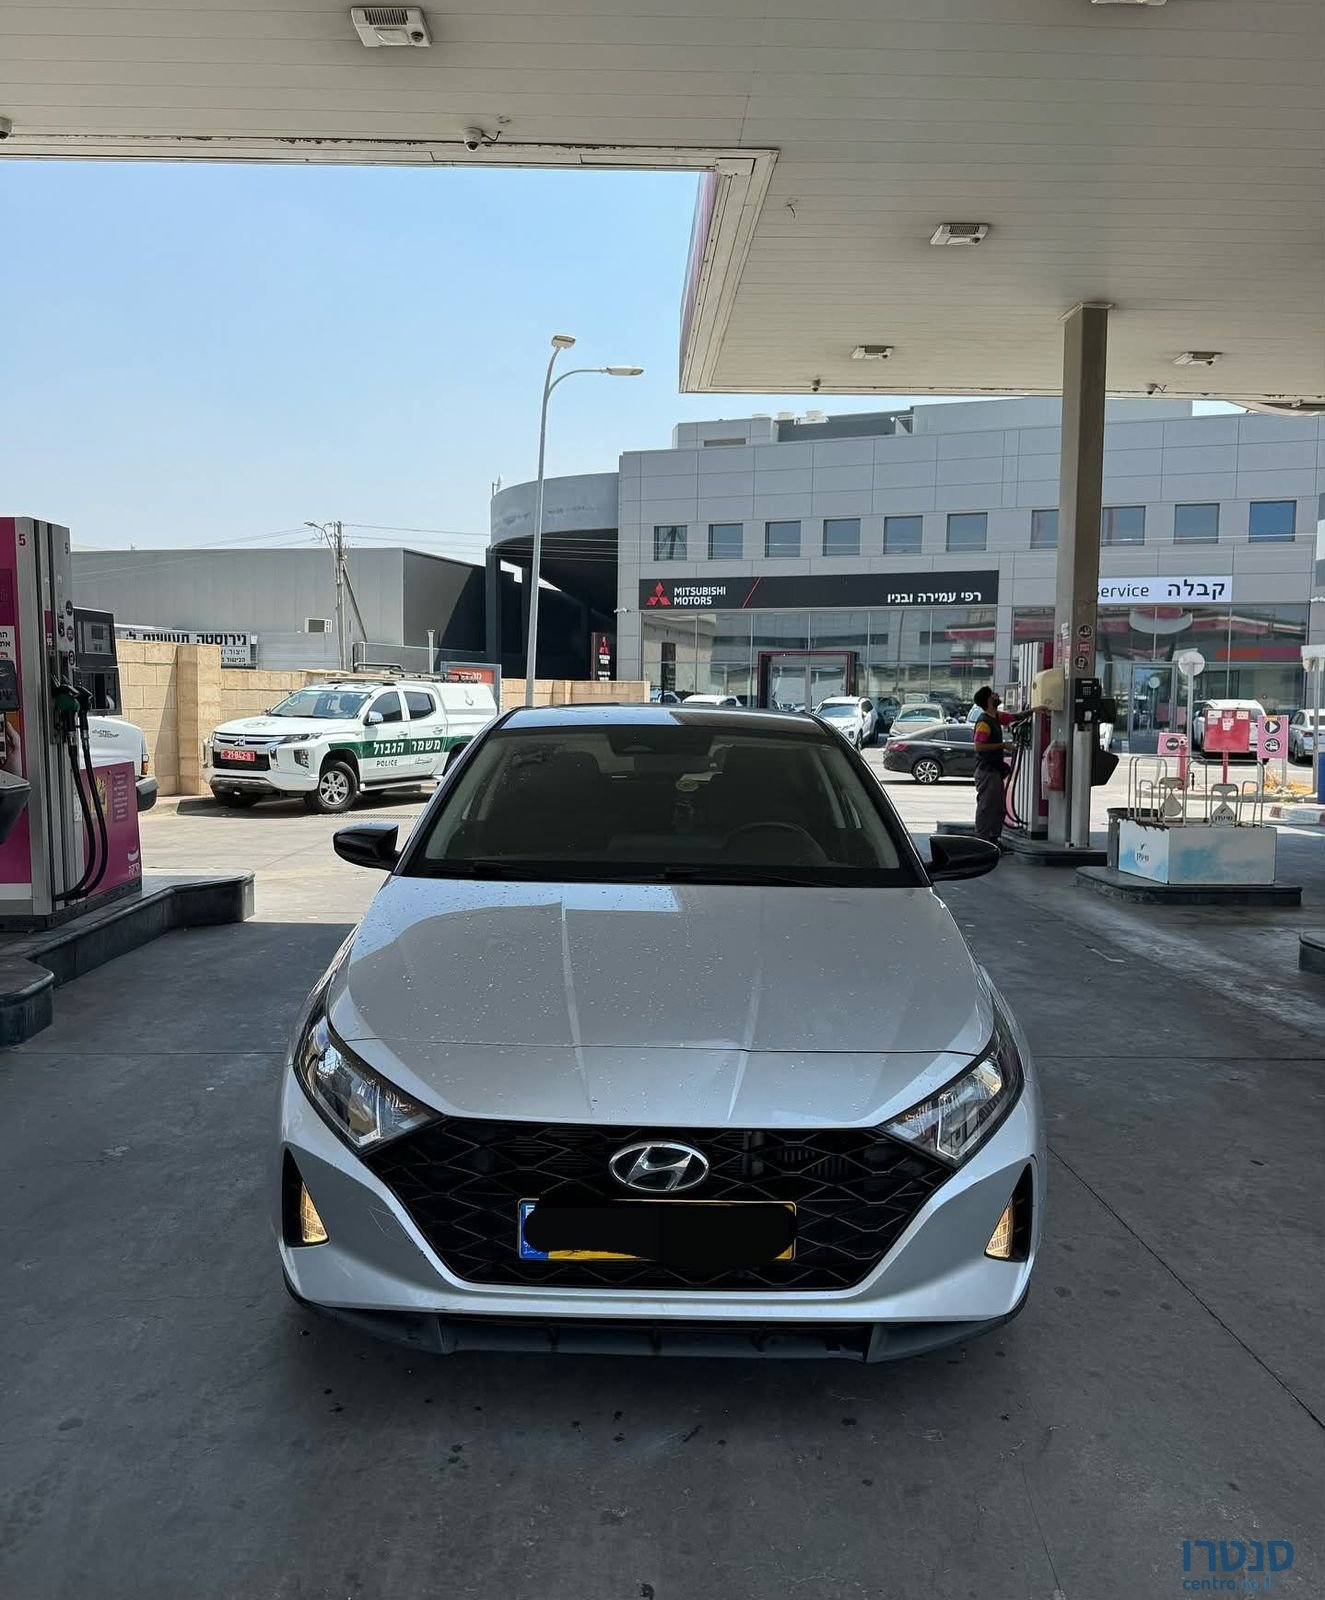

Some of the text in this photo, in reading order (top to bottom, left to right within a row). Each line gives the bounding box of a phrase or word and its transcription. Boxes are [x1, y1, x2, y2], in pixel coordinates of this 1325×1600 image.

[18, 533, 26, 547] 5
[64, 542, 69, 554] 5
[673, 586, 726, 596] MITSUBISHI
[1097, 584, 1150, 598] ervice
[1167, 579, 1225, 600] קבלה
[673, 596, 713, 606] MOTORS
[887, 591, 982, 604] רפי עמירה ובניו
[196, 633, 247, 646] נירוסטה
[373, 740, 441, 756] משמר הגבול
[376, 759, 398, 767] POLICE
